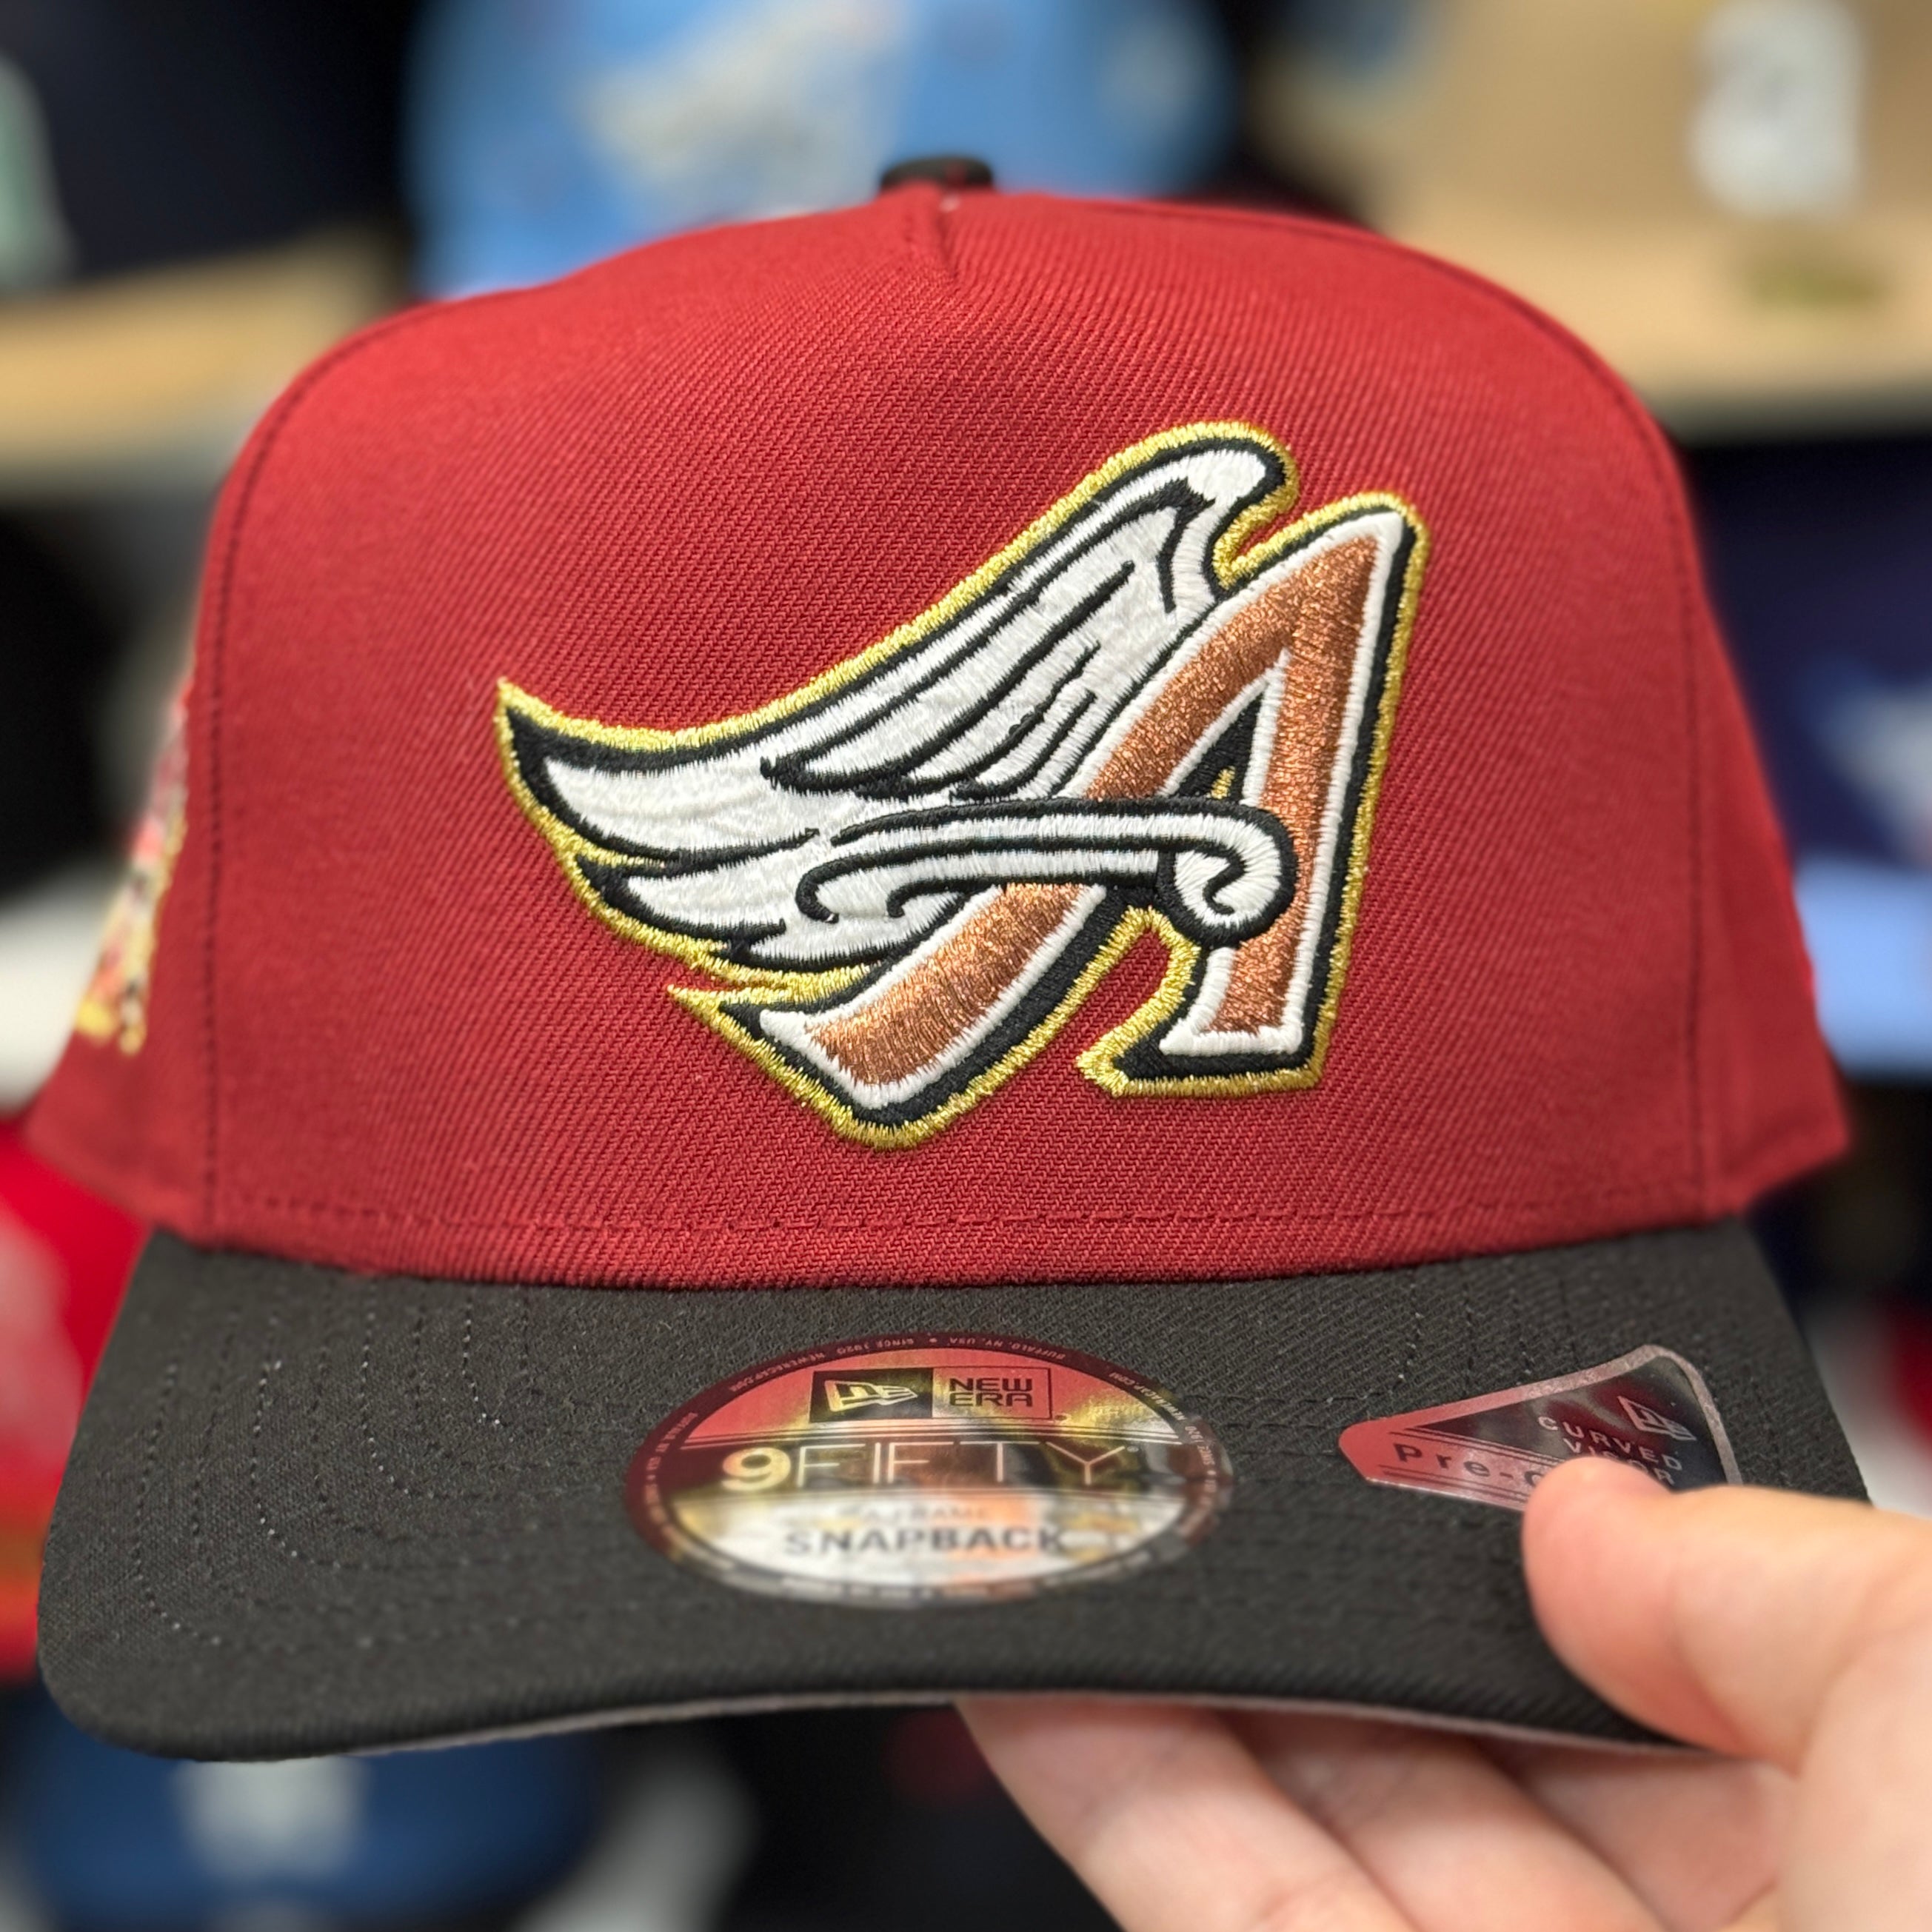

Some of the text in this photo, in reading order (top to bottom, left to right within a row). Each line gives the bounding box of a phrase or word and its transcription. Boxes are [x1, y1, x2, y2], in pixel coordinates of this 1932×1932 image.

[949, 1377, 1033, 1407] NEW ERA
[1536, 1416, 1683, 1471] CURVED
[722, 1441, 1126, 1492] 9FIFTY
[785, 1525, 1063, 1556] SNAPBACK
